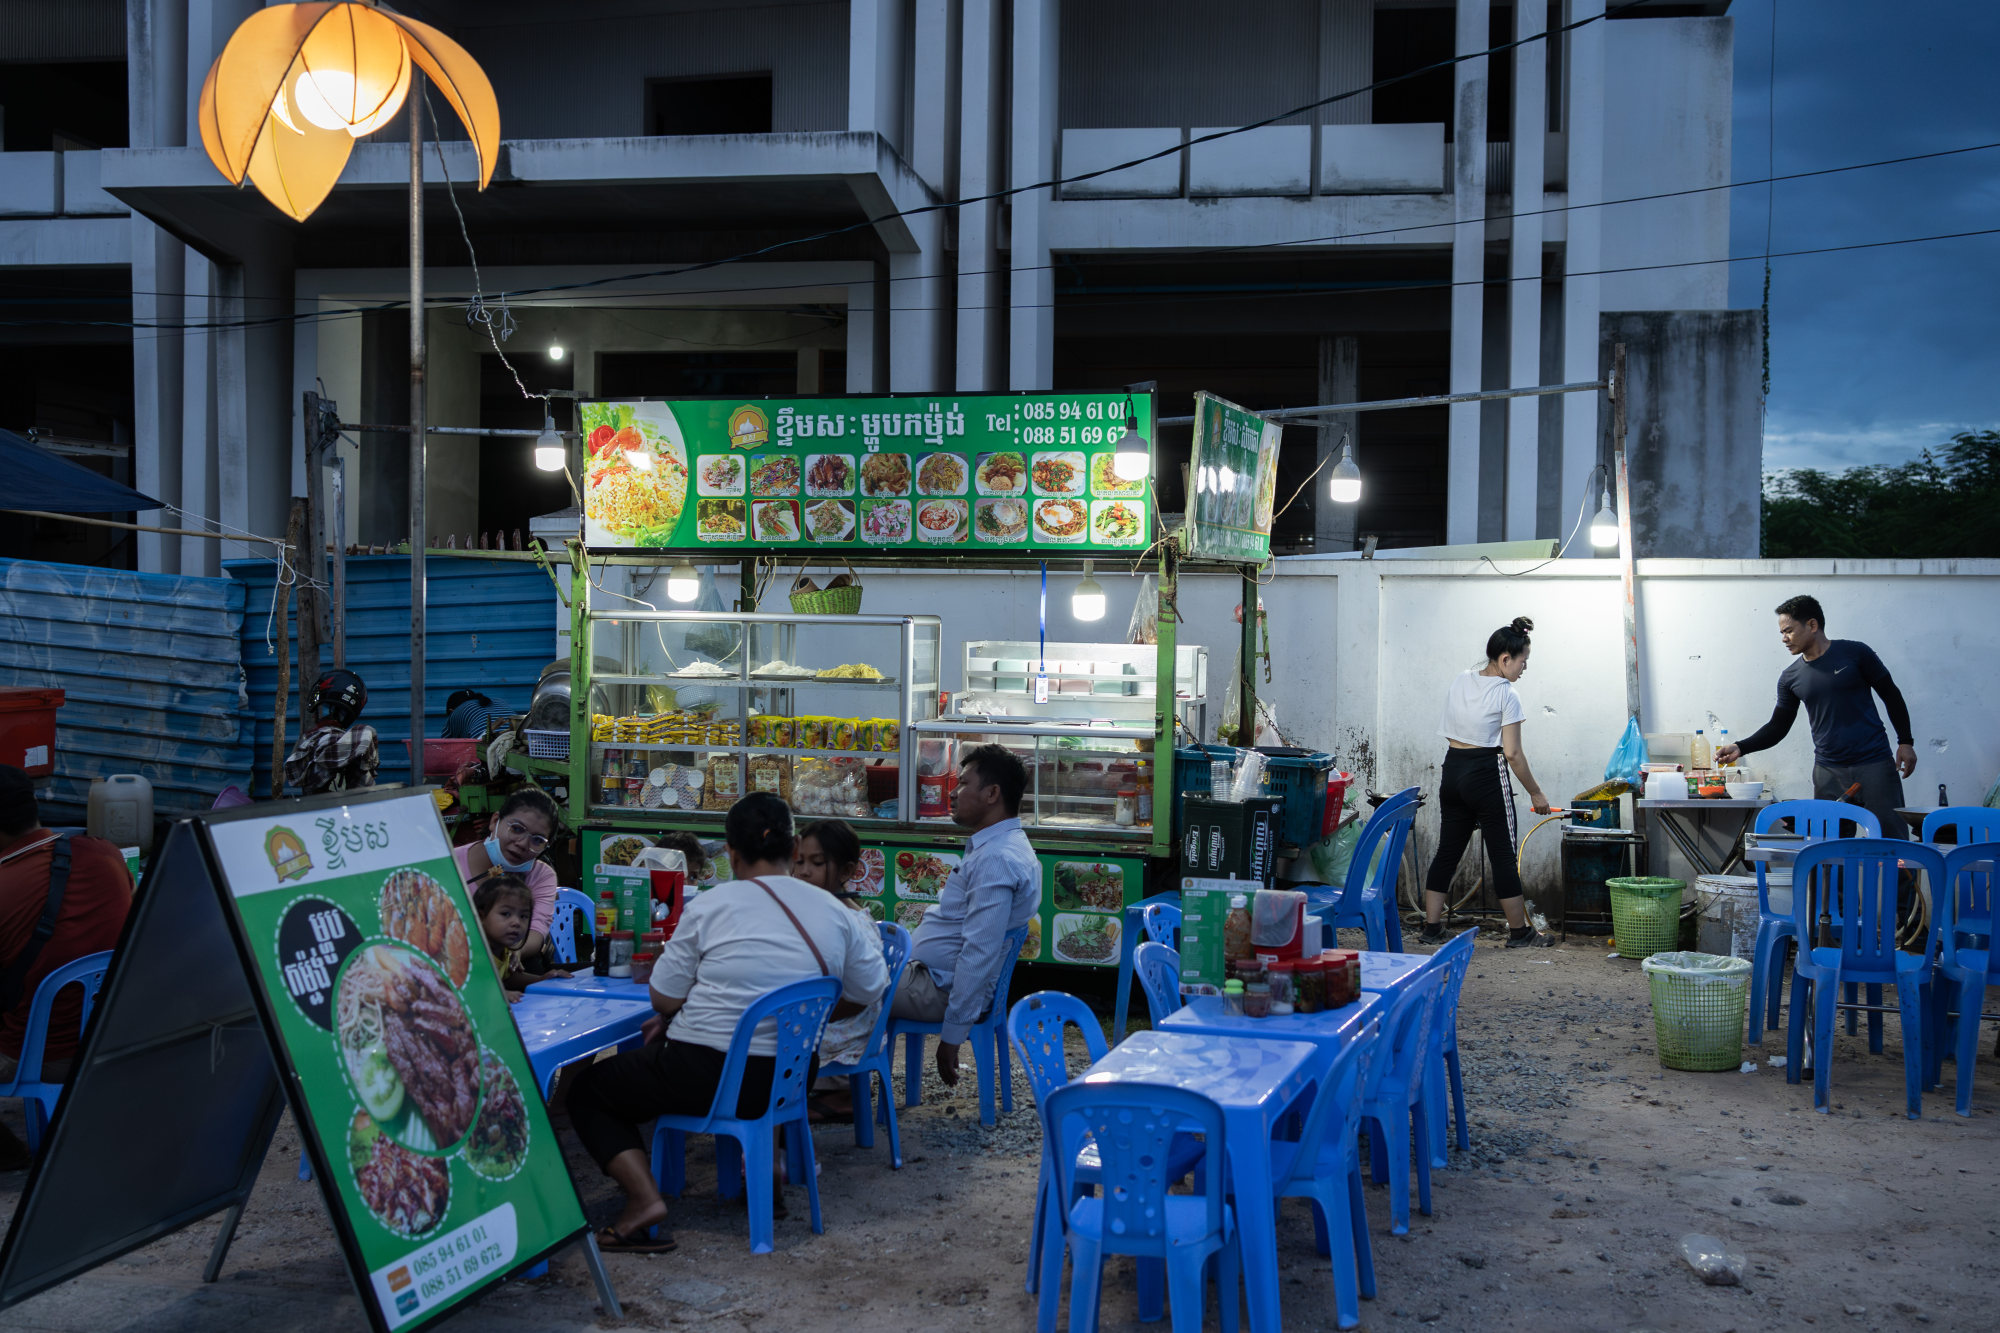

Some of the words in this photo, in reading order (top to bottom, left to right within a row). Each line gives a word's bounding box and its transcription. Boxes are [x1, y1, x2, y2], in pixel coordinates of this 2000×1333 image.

[1023, 402, 1055, 420] 085
[1059, 400, 1082, 420] 94
[1086, 401, 1103, 420] 61
[1108, 401, 1126, 420] 01
[985, 413, 1011, 432] Tel
[1023, 426, 1055, 445] 088
[1059, 426, 1076, 444] 51
[1081, 426, 1103, 444] 69
[1106, 426, 1128, 444] 67
[412, 1252, 438, 1276] 085
[438, 1242, 455, 1262] 94
[455, 1234, 472, 1252] 61
[472, 1225, 488, 1244] 01
[420, 1274, 446, 1299] 088
[446, 1265, 462, 1286] 51
[463, 1255, 479, 1275] 69
[480, 1242, 503, 1266] 672
